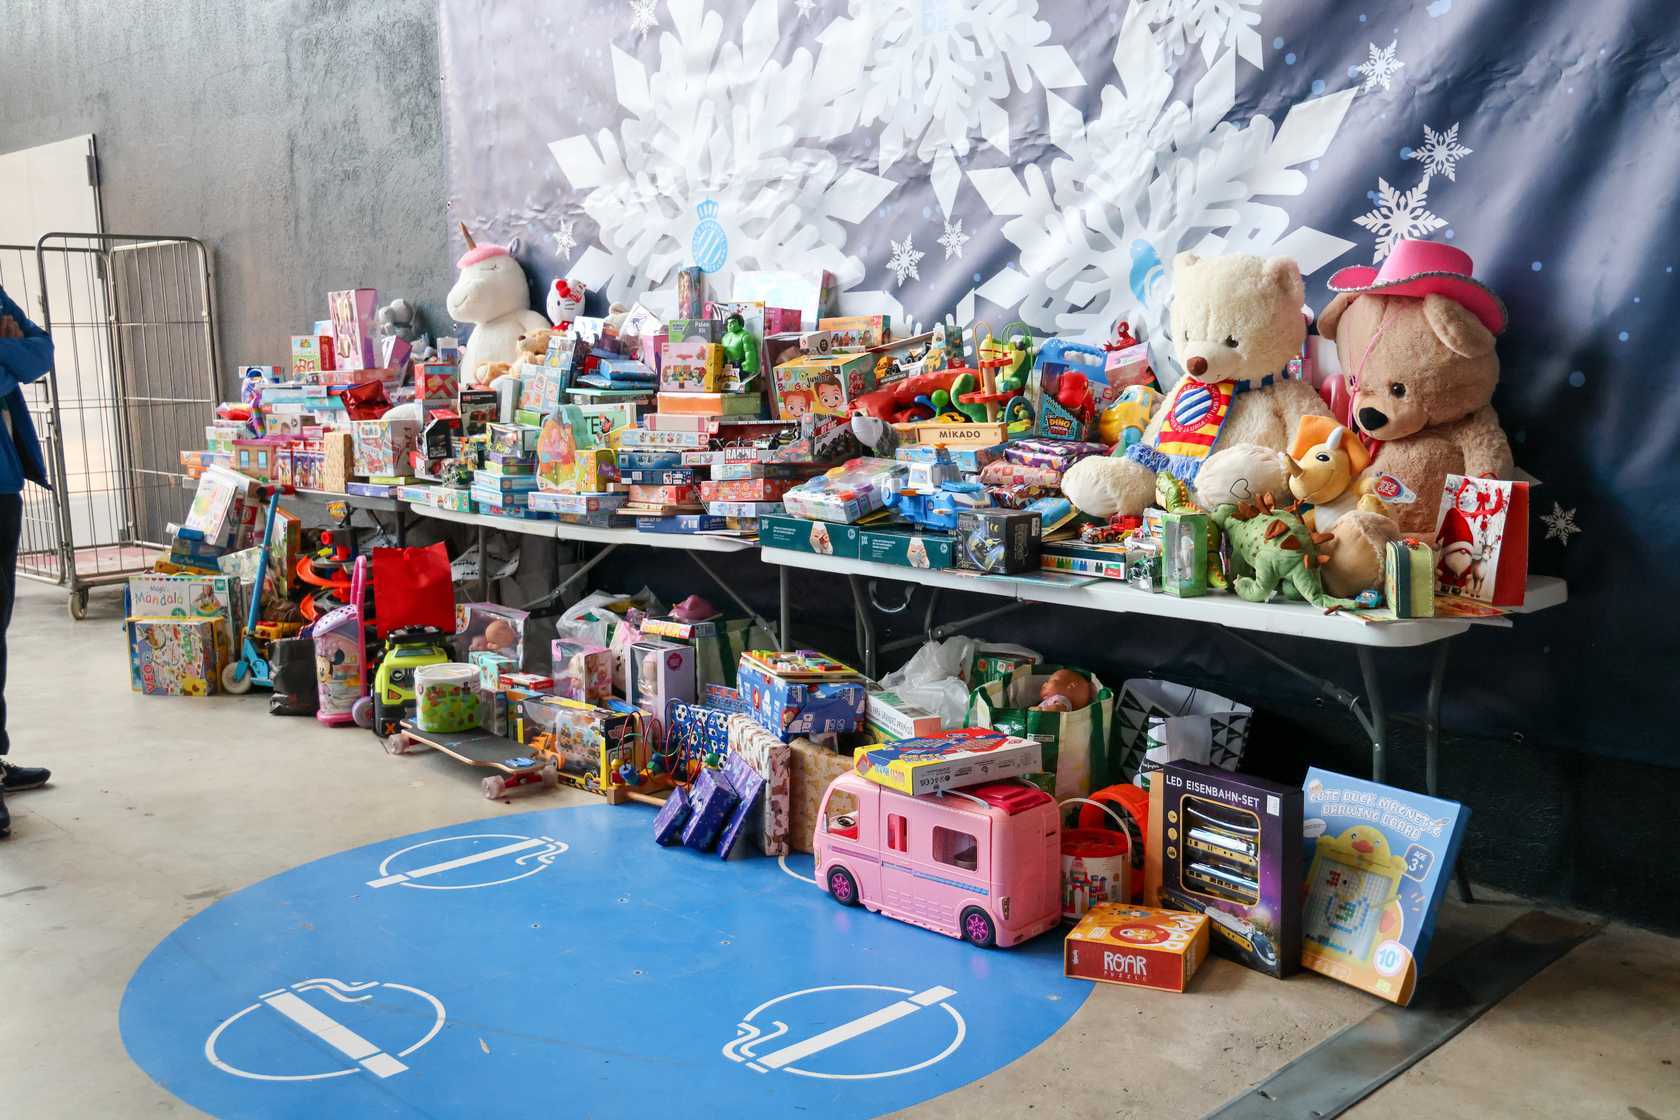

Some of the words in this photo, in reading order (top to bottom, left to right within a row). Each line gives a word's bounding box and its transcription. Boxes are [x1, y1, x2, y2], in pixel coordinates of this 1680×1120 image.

[939, 430, 981, 439] MIKADO
[135, 591, 183, 606] Mandala
[1165, 774, 1183, 788] LED
[1186, 780, 1260, 808] EISENBAHN-SET
[1408, 858, 1424, 872] 3+
[1103, 951, 1147, 976] ROAR
[1378, 949, 1397, 968] 10
